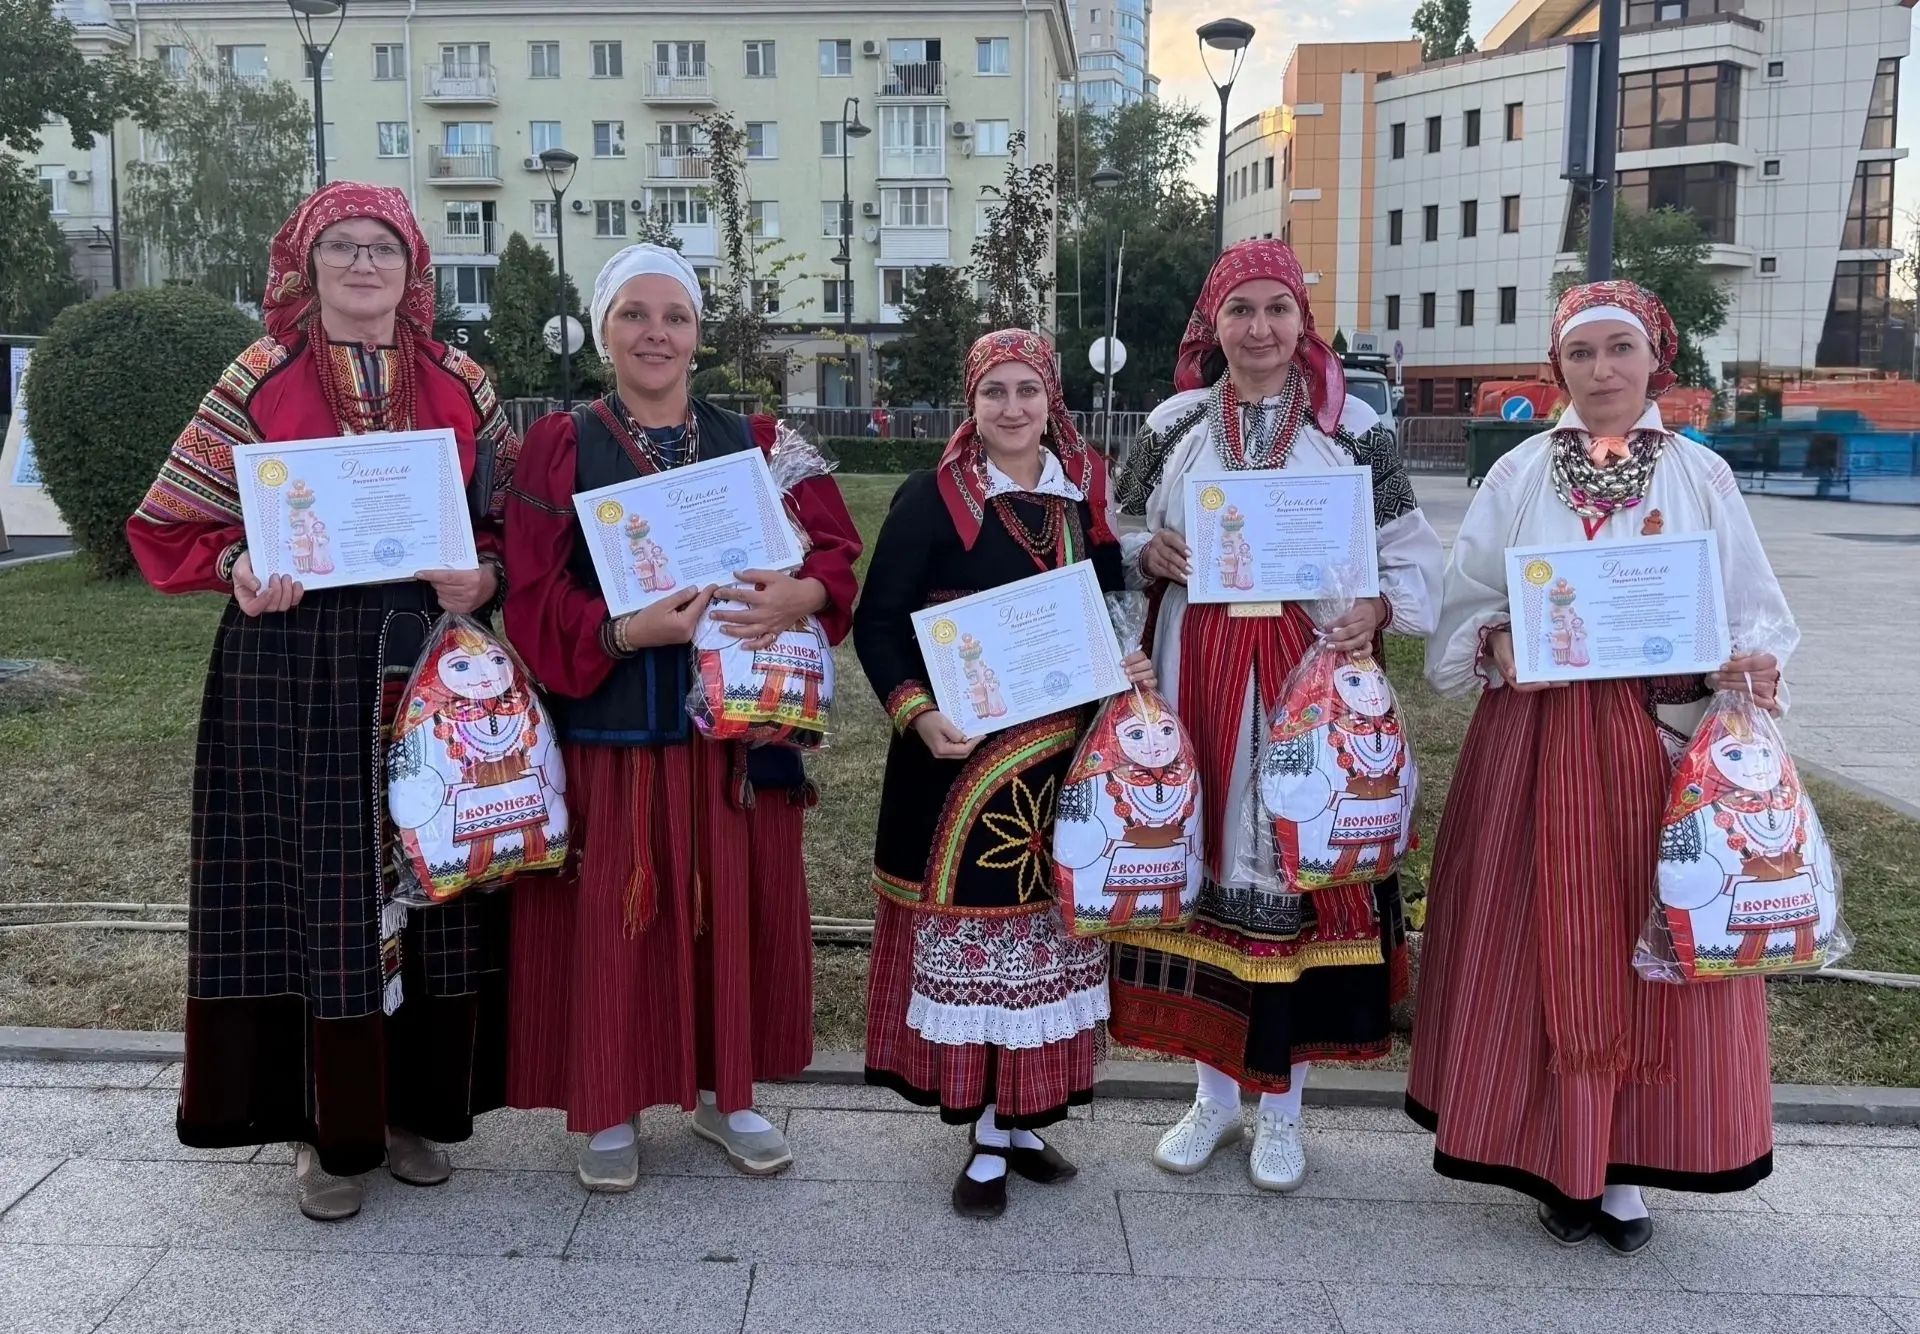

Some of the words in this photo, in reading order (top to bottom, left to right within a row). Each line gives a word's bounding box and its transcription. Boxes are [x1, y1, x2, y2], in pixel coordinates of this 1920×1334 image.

[337, 459, 411, 479] Диплом
[666, 485, 728, 507] Диплом
[1264, 490, 1328, 507] Диплом
[1598, 559, 1670, 578] Диплом
[998, 602, 1058, 626] Диплом
[465, 793, 538, 820] ВОРОНЕЖ
[1343, 812, 1398, 827] ВОРОНЕЖ
[1118, 860, 1181, 874] ВОРОНЕЖ
[1743, 893, 1811, 912] ВОРОНЕЖ
